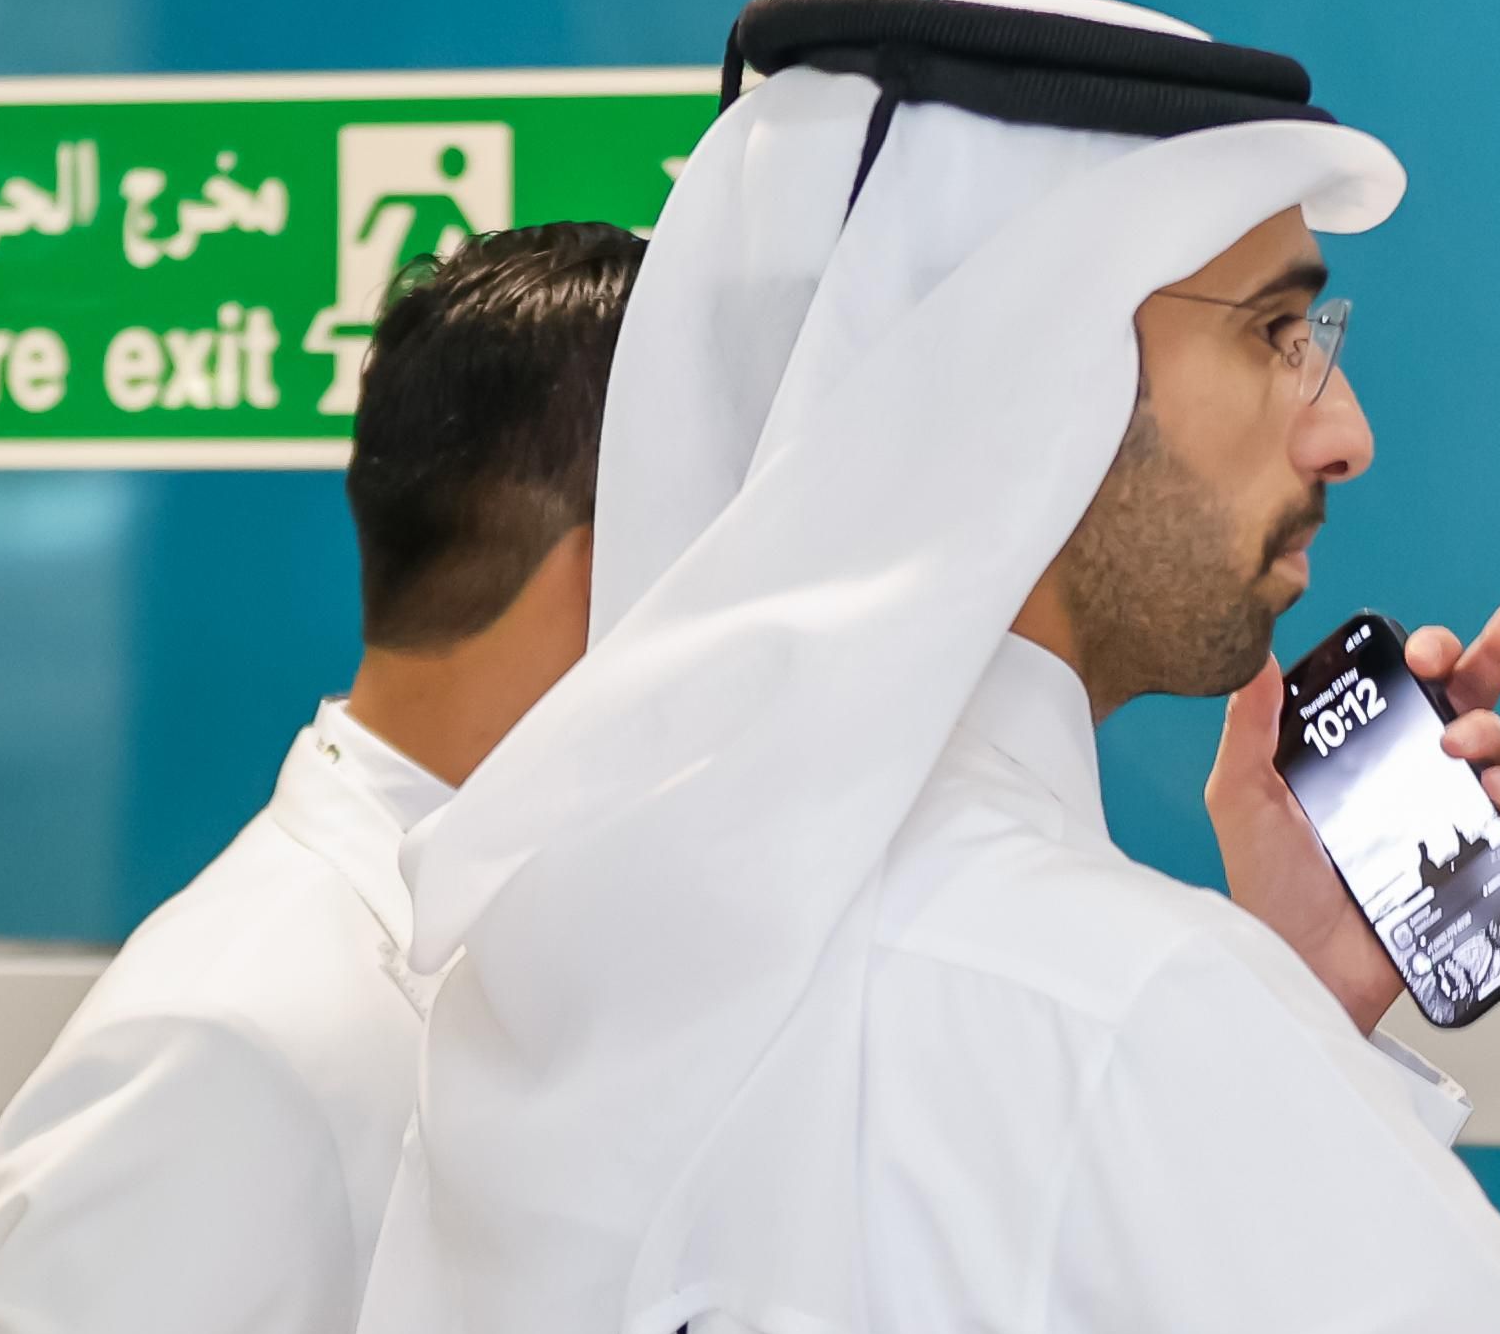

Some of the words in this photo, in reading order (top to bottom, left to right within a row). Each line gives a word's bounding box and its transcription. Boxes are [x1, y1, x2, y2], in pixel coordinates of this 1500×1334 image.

[119, 149, 291, 269] مخرج
[103, 300, 281, 412] exit
[1303, 677, 1388, 758] 10:12
